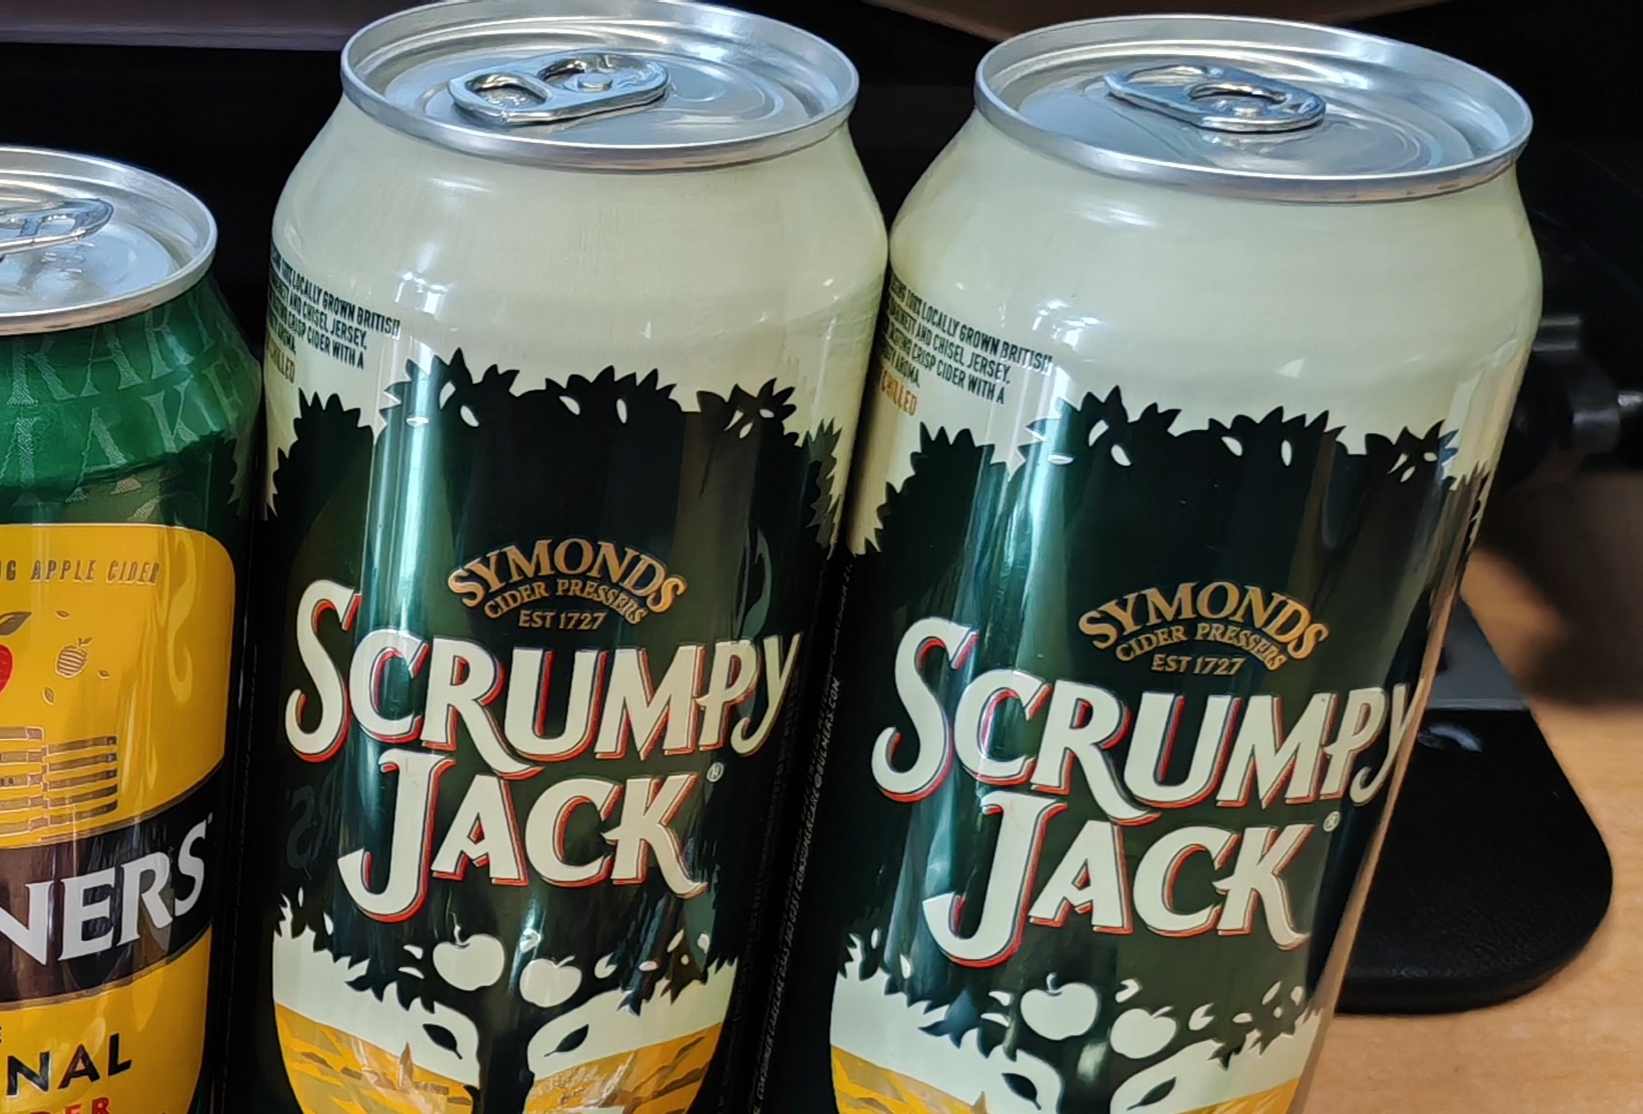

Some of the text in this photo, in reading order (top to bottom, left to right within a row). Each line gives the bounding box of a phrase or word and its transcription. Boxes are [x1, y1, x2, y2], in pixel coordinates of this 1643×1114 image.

[323, 290, 356, 322] GROWN
[922, 301, 959, 338] LOCALLY
[959, 324, 1001, 356] GROWN
[307, 326, 331, 357] CIDER
[332, 339, 356, 367] WITH
[933, 333, 966, 367] CHISEL
[912, 343, 937, 371] CRISP
[937, 360, 966, 391] CIDER
[968, 374, 996, 403] WITH
[996, 387, 1005, 405] A
[30, 560, 97, 583] APPLE
[105, 561, 160, 586] CIDER
[447, 537, 688, 613] SYMONDS
[483, 578, 648, 625] CIDER PRESSERS
[518, 609, 606, 631] EST 1727
[1078, 581, 1330, 660] SYMONDS
[1115, 622, 1289, 671] CIDER PRESSERS
[1151, 654, 1247, 676] EST 1727
[285, 579, 804, 781] SCRUMPY
[871, 616, 1426, 825] SCRUMPY
[337, 749, 706, 923] JACK
[923, 790, 1311, 967] JACK
